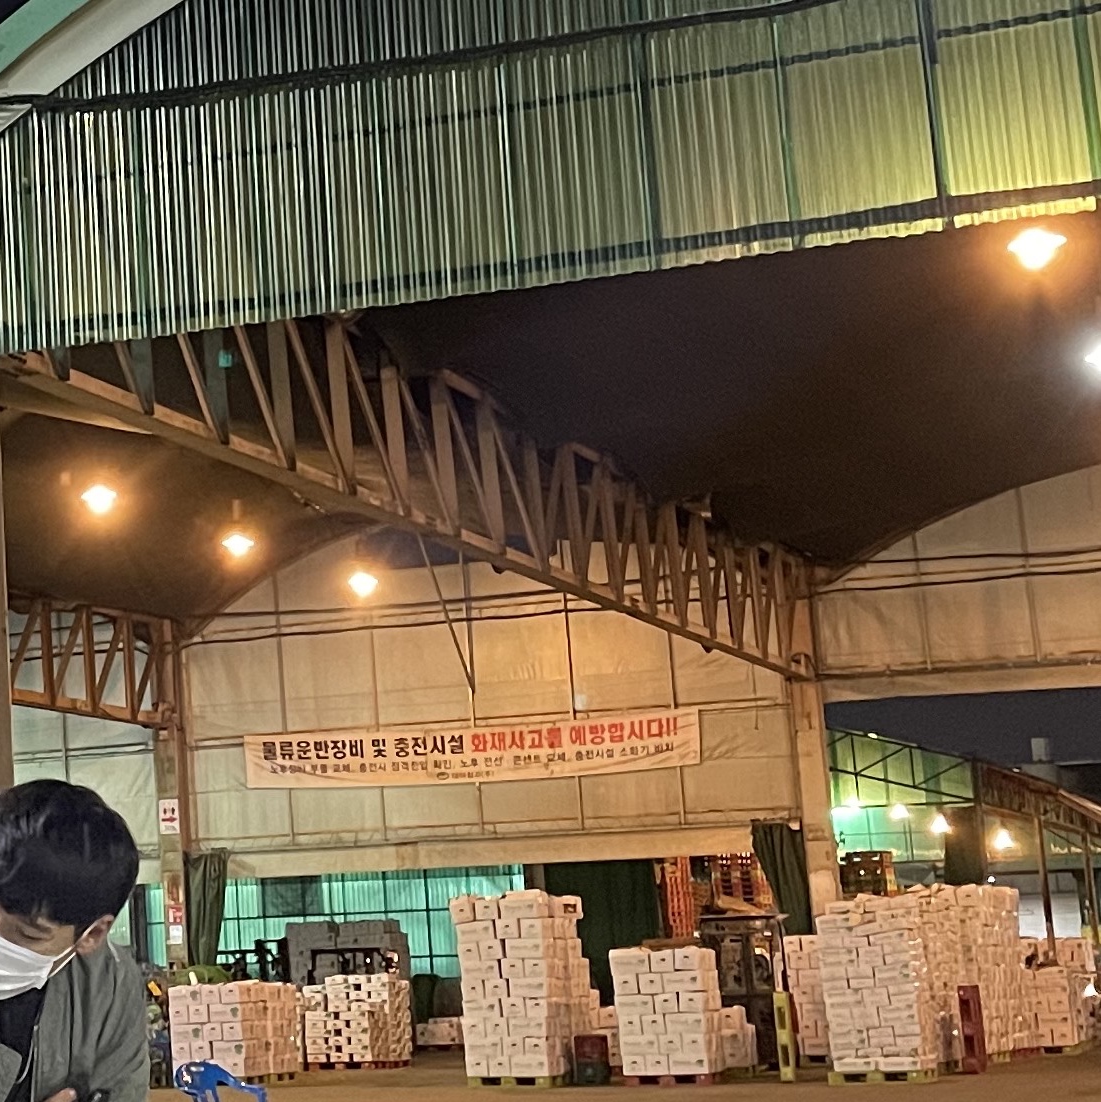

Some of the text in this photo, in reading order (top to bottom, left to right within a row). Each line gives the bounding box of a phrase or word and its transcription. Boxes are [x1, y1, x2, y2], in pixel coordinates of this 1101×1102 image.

[262, 716, 679, 761] 물류운반장비 및 충전시설 화재사고를 예방합시다!!
